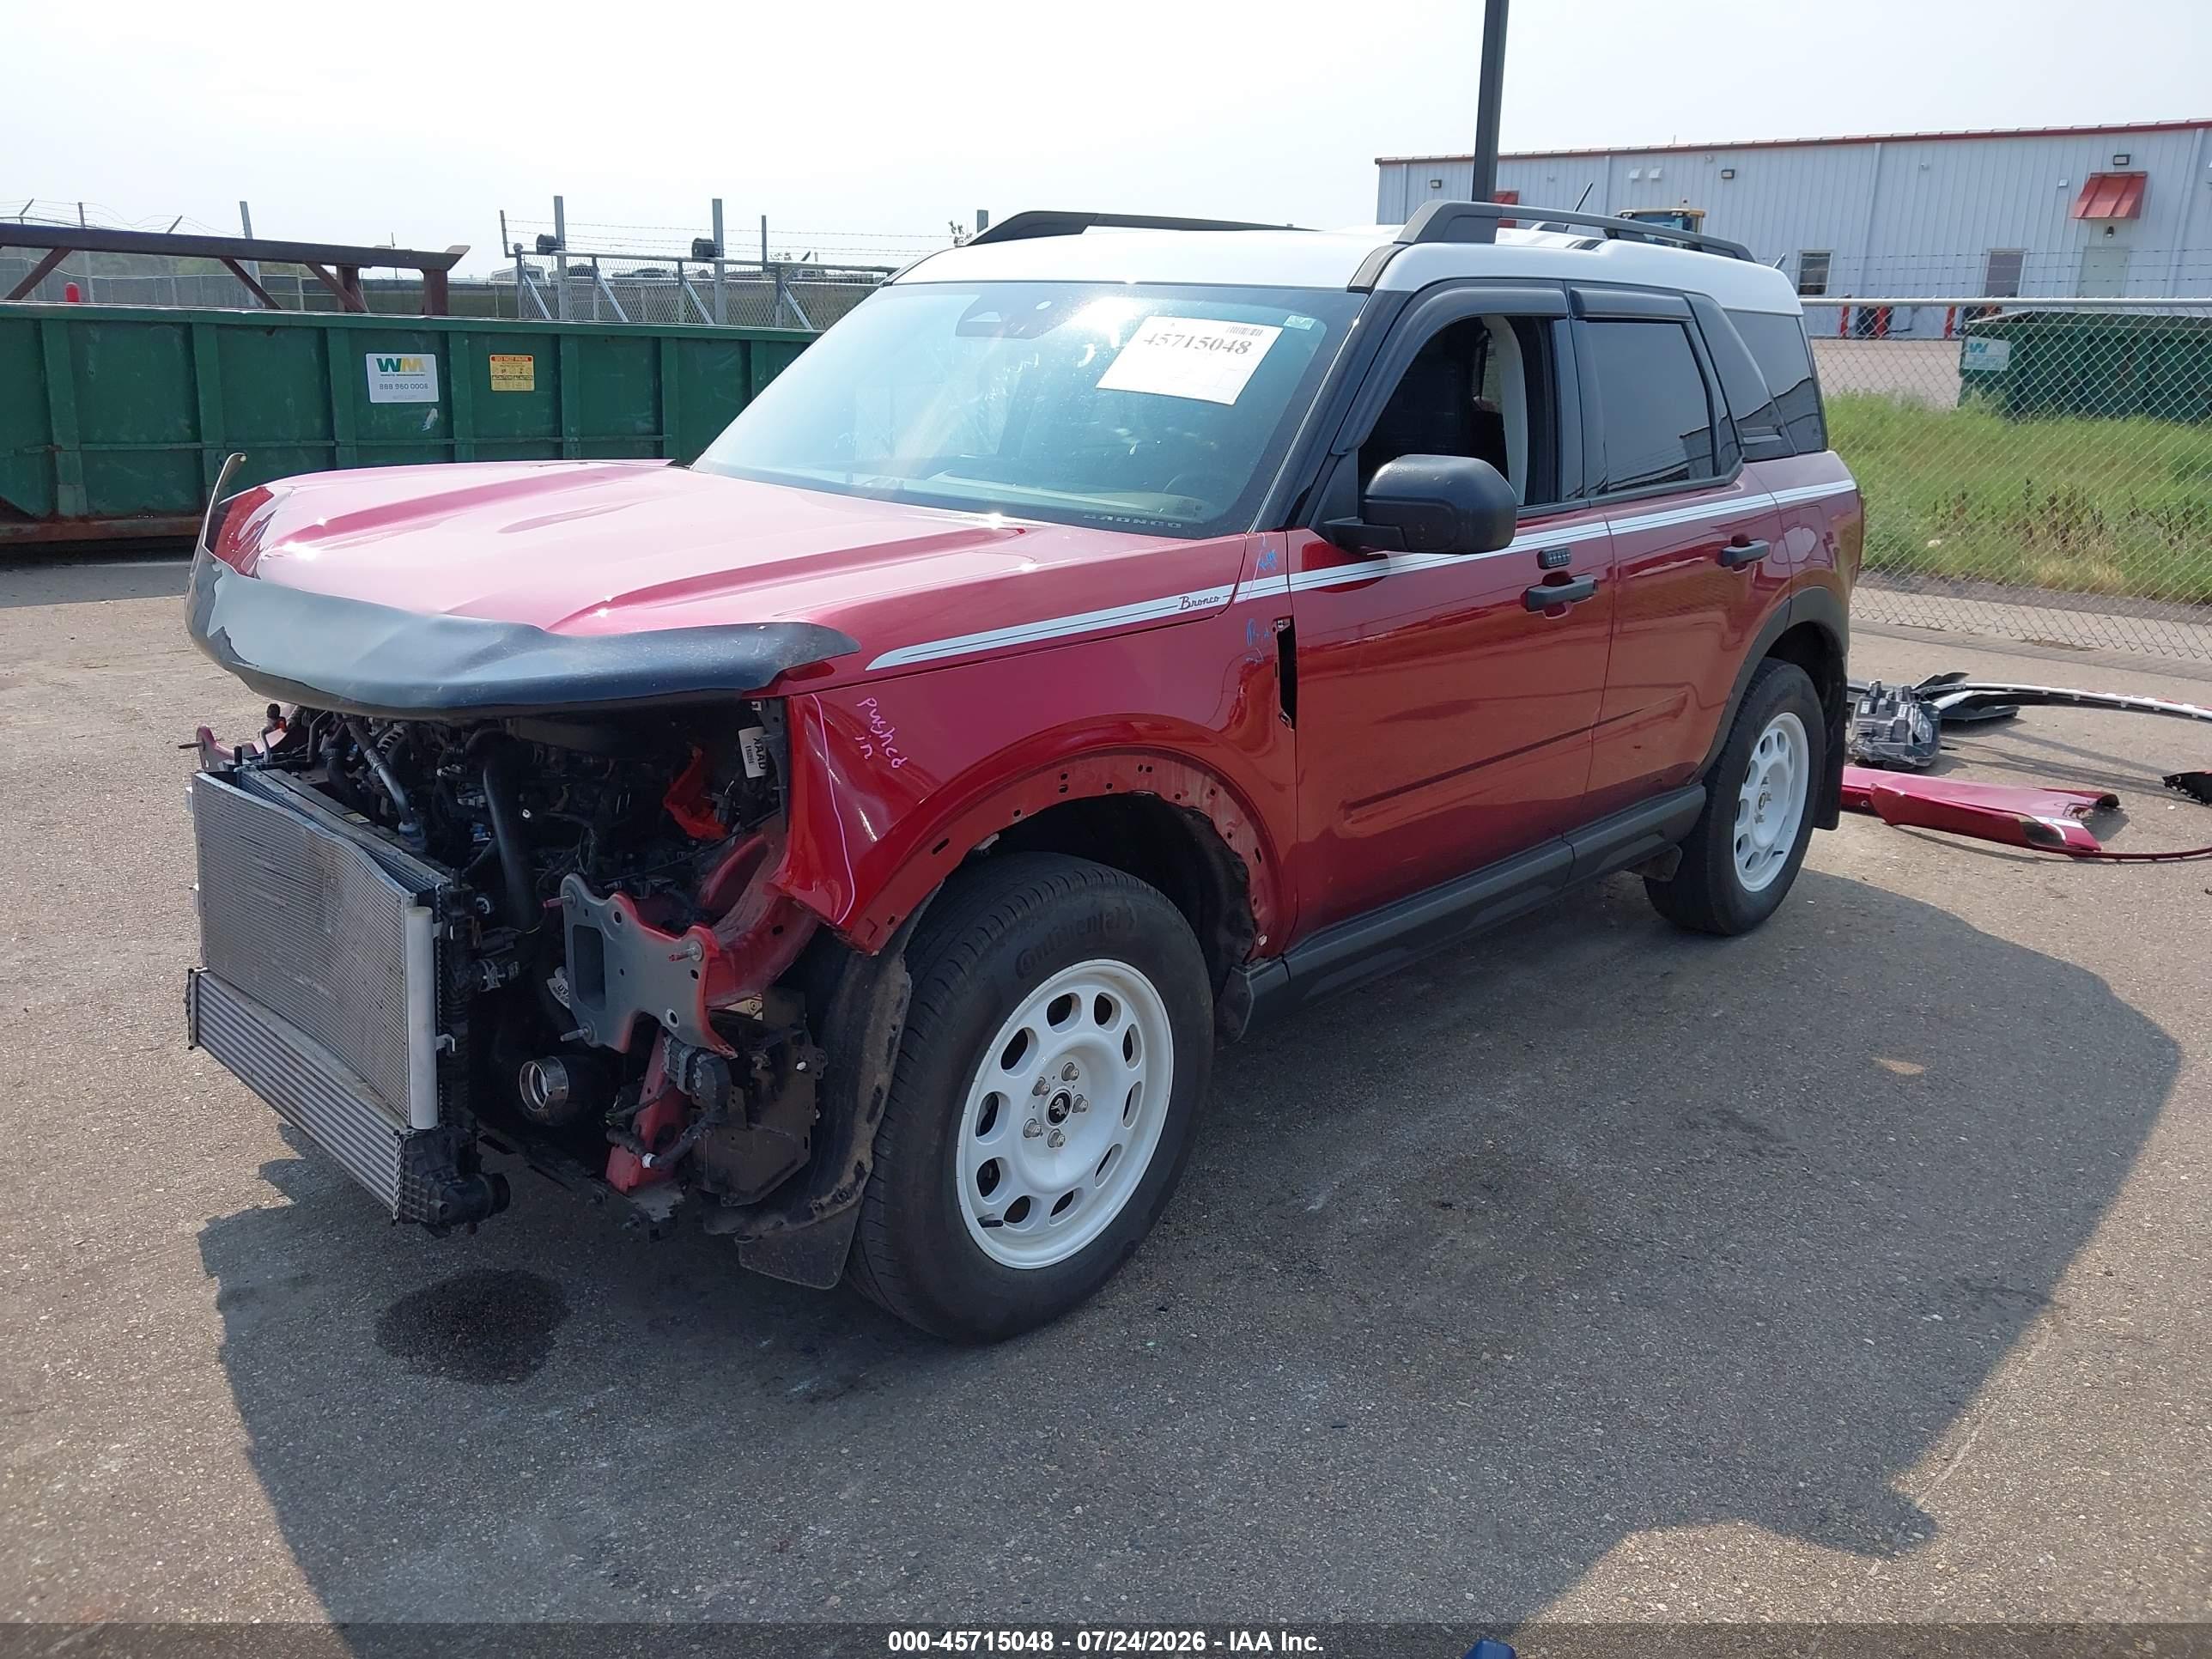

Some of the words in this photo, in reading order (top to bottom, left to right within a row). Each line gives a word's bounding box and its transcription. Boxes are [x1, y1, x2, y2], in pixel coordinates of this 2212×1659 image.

[1143, 332, 1253, 355] 45715048
[376, 357, 426, 372] WM
[1178, 595, 1220, 610] Bronco
